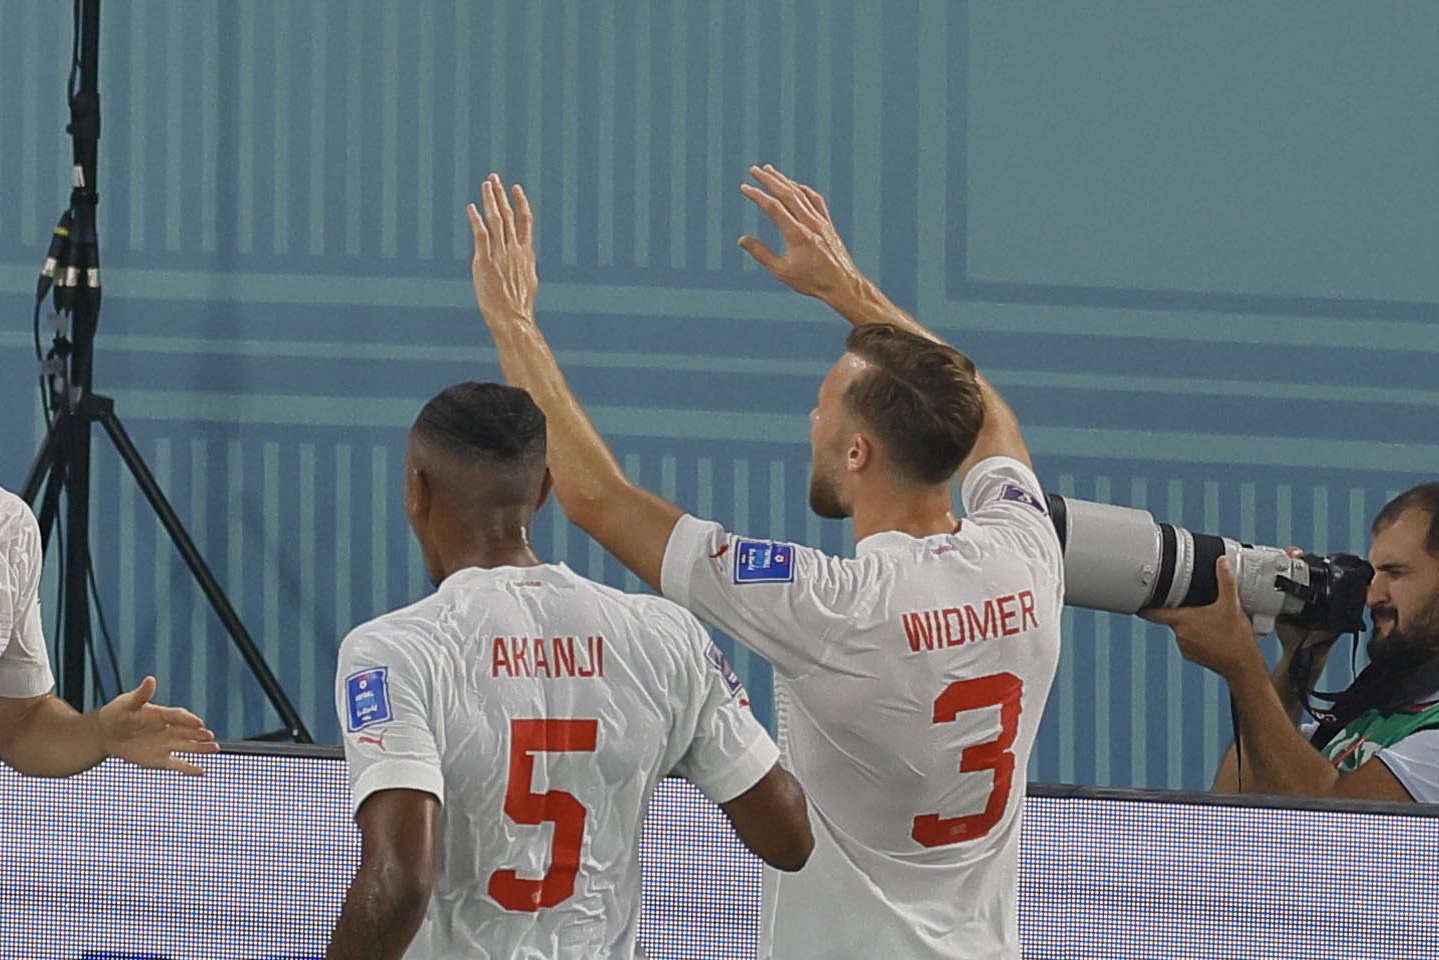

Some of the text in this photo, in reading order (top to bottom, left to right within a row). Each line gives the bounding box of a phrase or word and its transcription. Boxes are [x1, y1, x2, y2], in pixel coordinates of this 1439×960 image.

[492, 636, 604, 679] AKANJI
[902, 590, 1037, 653] WIDMER
[487, 718, 598, 912] 5
[911, 671, 1024, 849] 3
